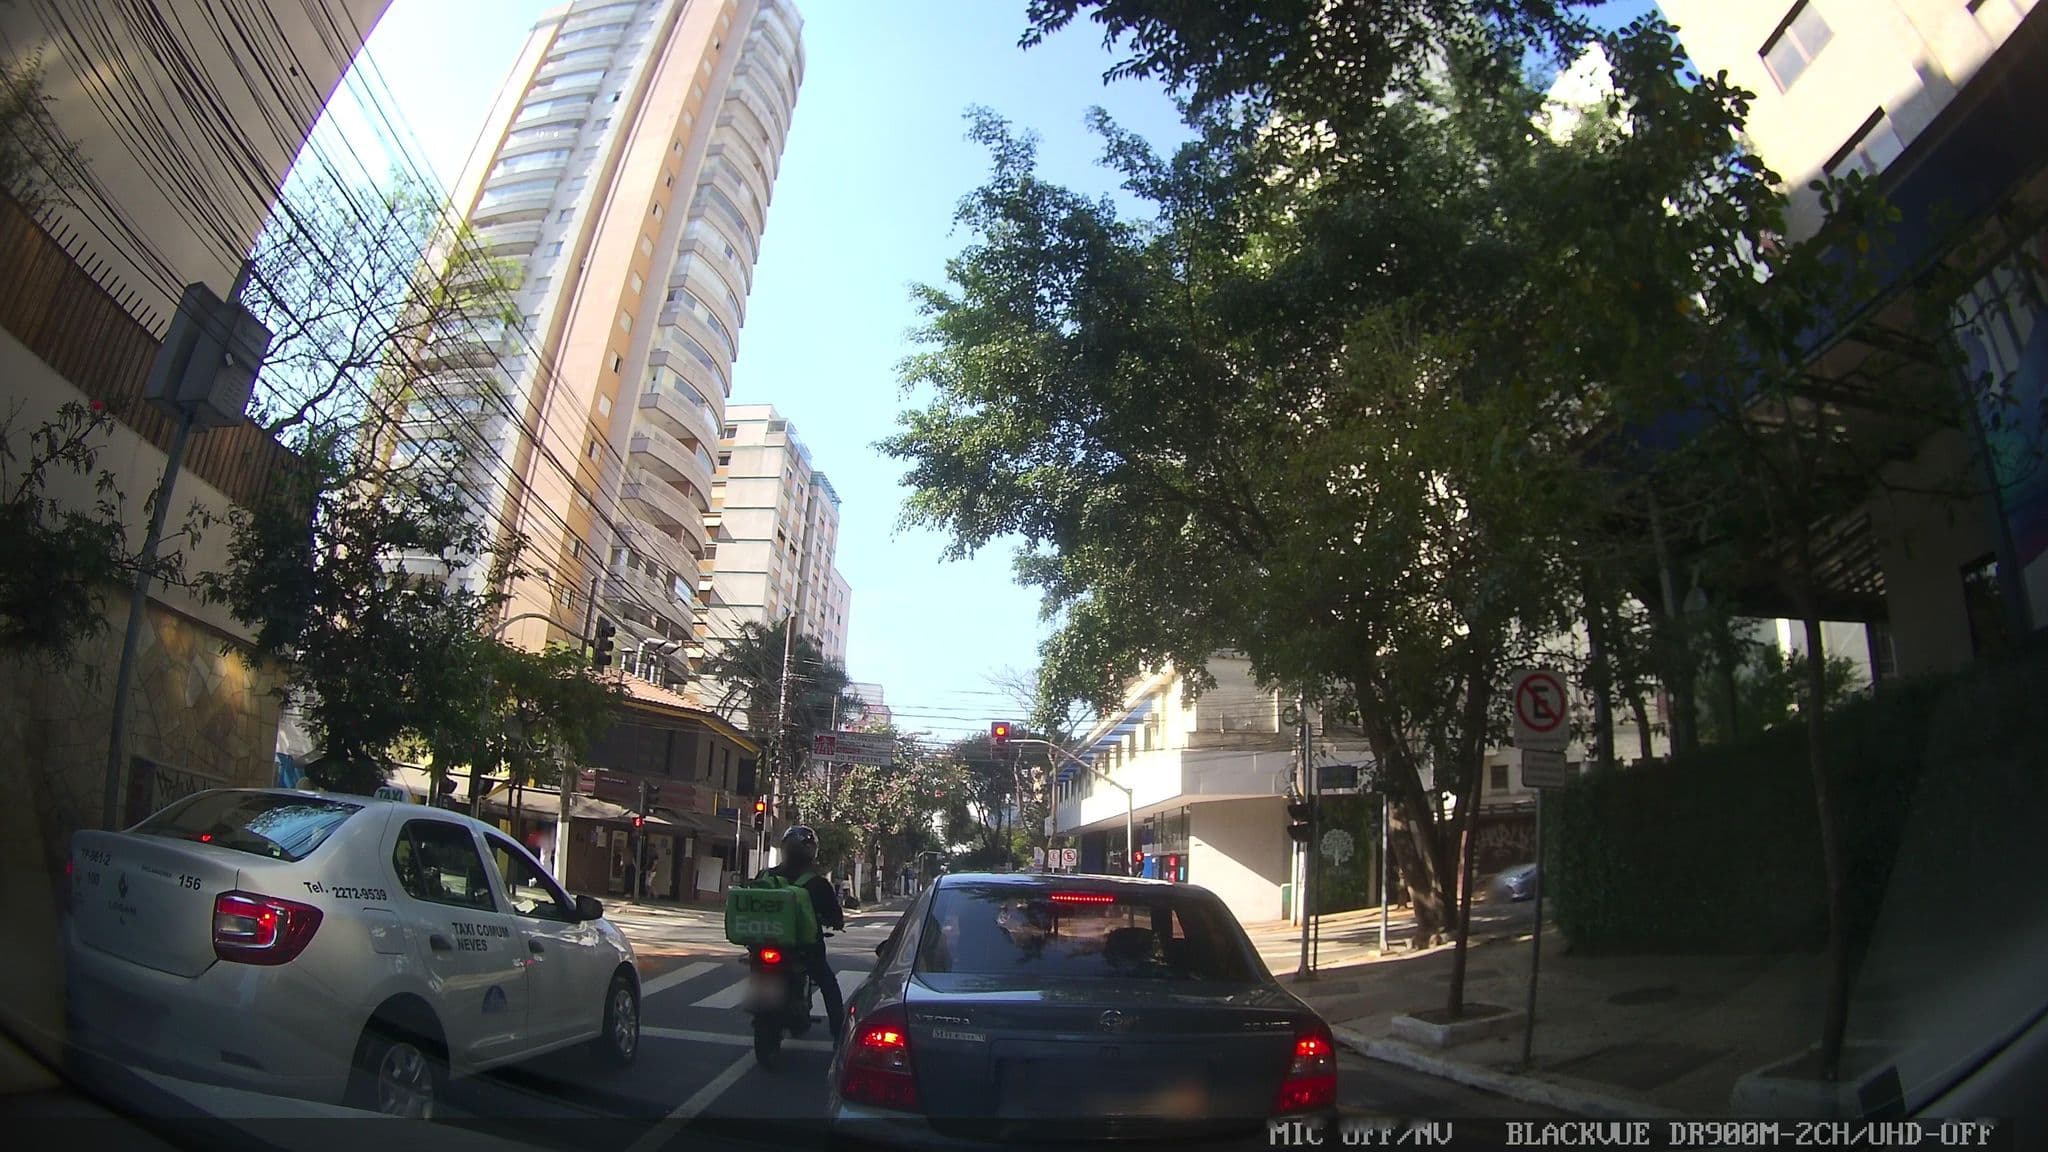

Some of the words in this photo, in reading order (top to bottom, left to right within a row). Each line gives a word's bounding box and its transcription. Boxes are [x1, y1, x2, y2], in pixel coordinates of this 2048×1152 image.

[1533, 686, 1553, 719] E
[378, 788, 404, 801] TAXI
[178, 873, 202, 891] 156
[303, 881, 329, 894] Tel.
[332, 886, 387, 900] 2272-9539
[735, 895, 784, 913] Uber
[452, 922, 476, 935] TAXI
[476, 924, 510, 938] COMUM
[735, 914, 784, 935] Eats
[456, 938, 488, 952] NEVES
